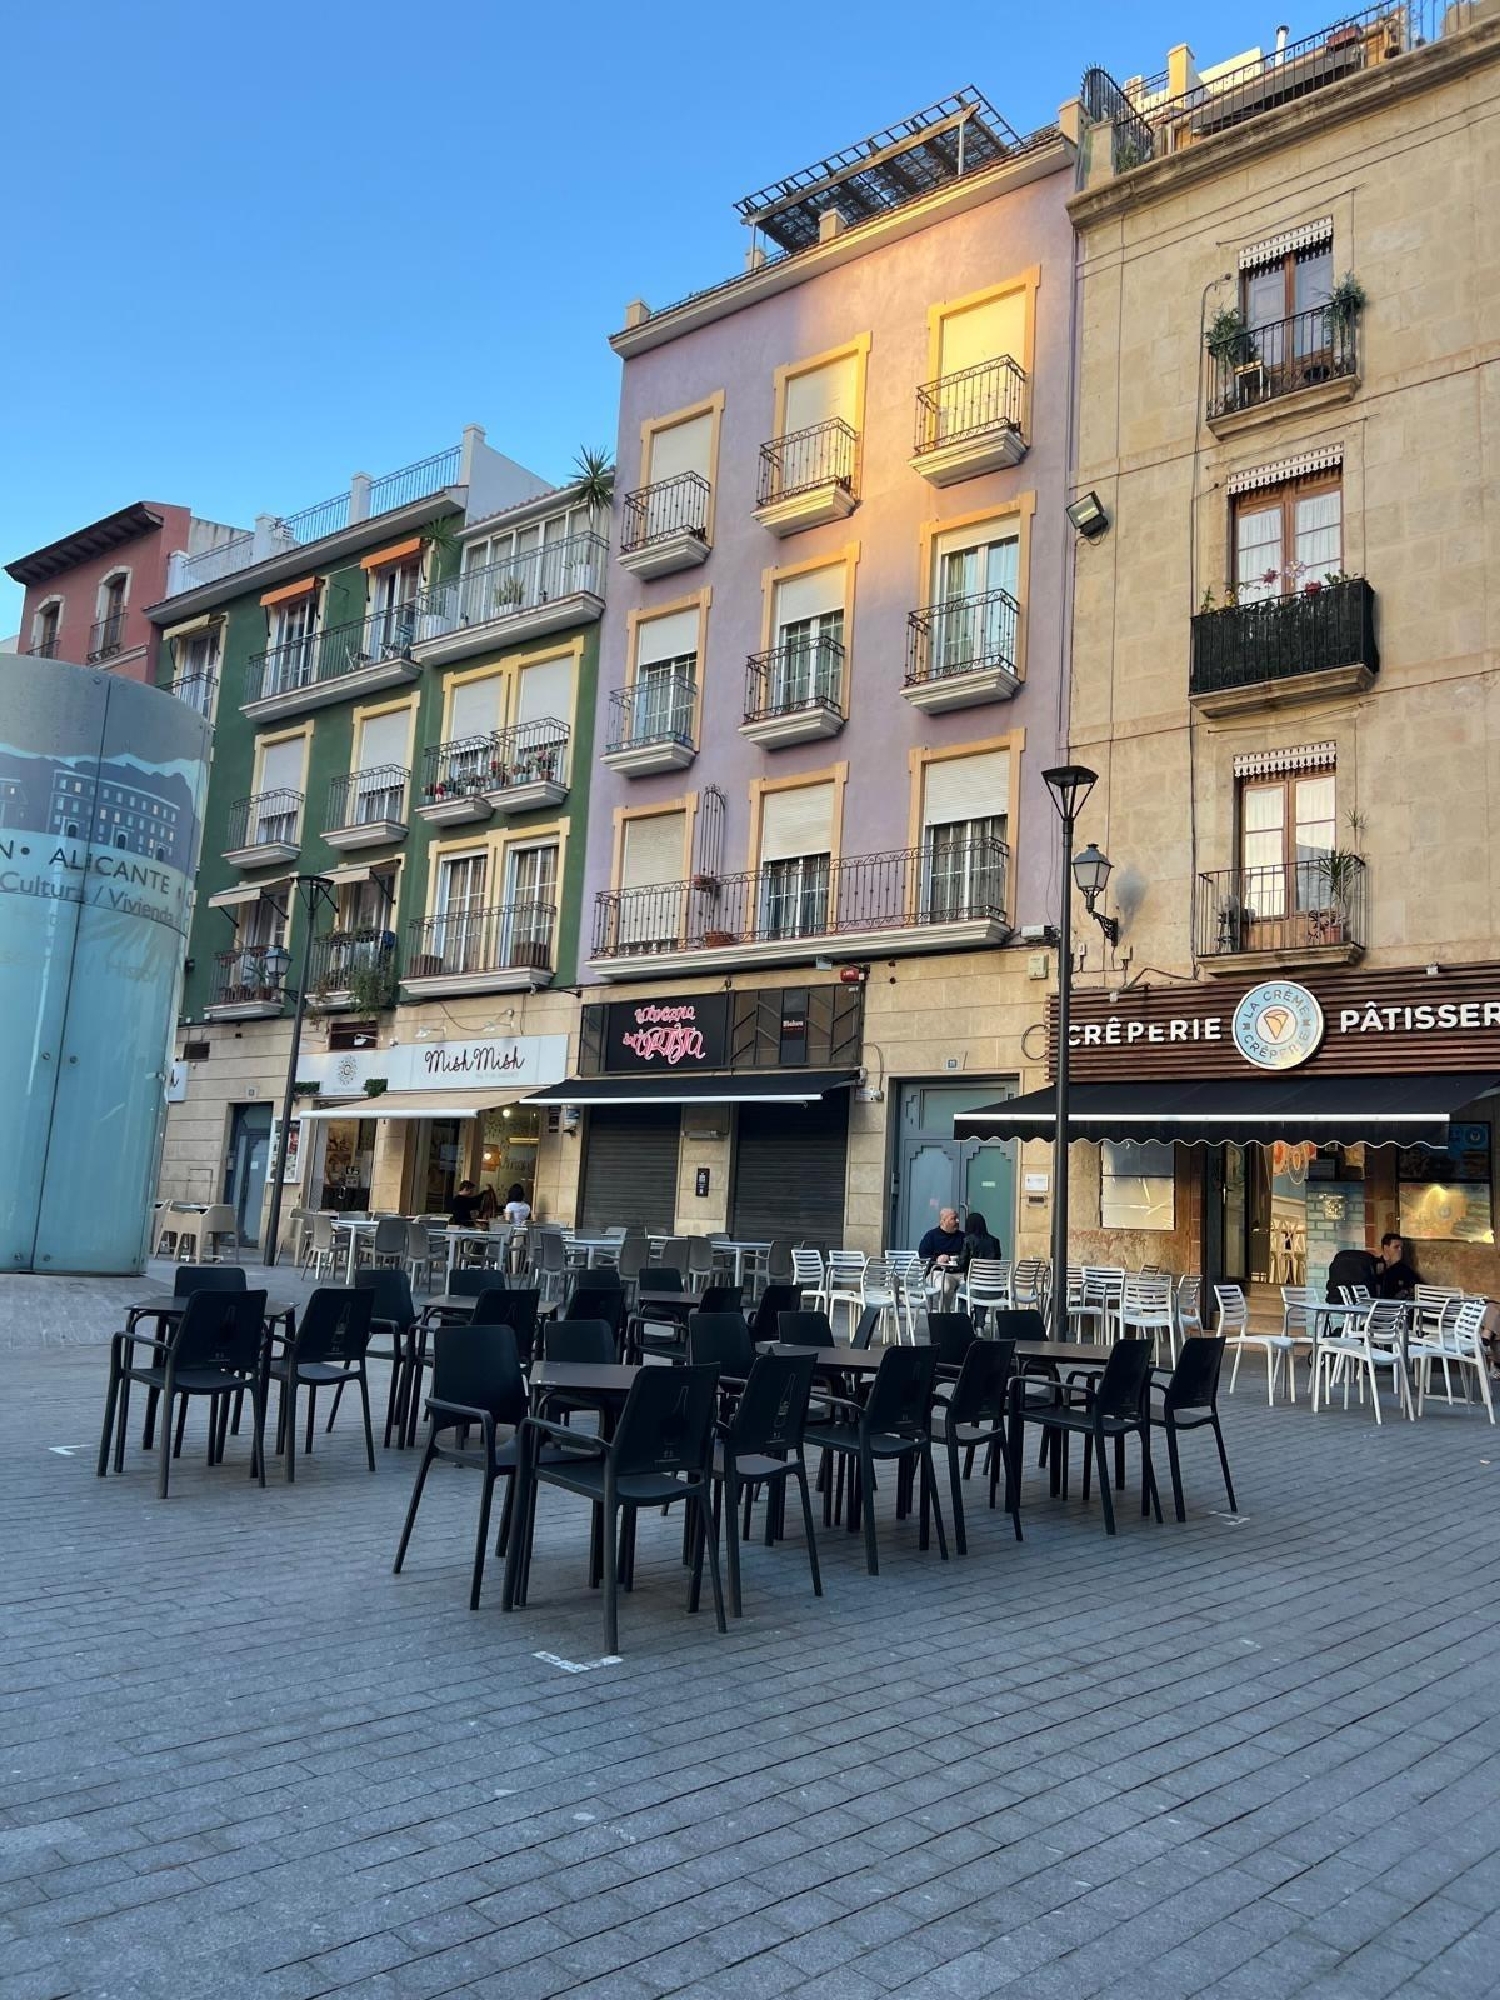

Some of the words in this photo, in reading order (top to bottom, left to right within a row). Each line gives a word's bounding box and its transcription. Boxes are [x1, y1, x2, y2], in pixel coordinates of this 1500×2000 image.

[49, 848, 170, 895] ALICANTE
[1243, 1002, 1260, 1019] LA
[1068, 1018, 1222, 1046] CRÊPERIE
[425, 1049, 474, 1074] Mish
[474, 1045, 525, 1071] Mish
